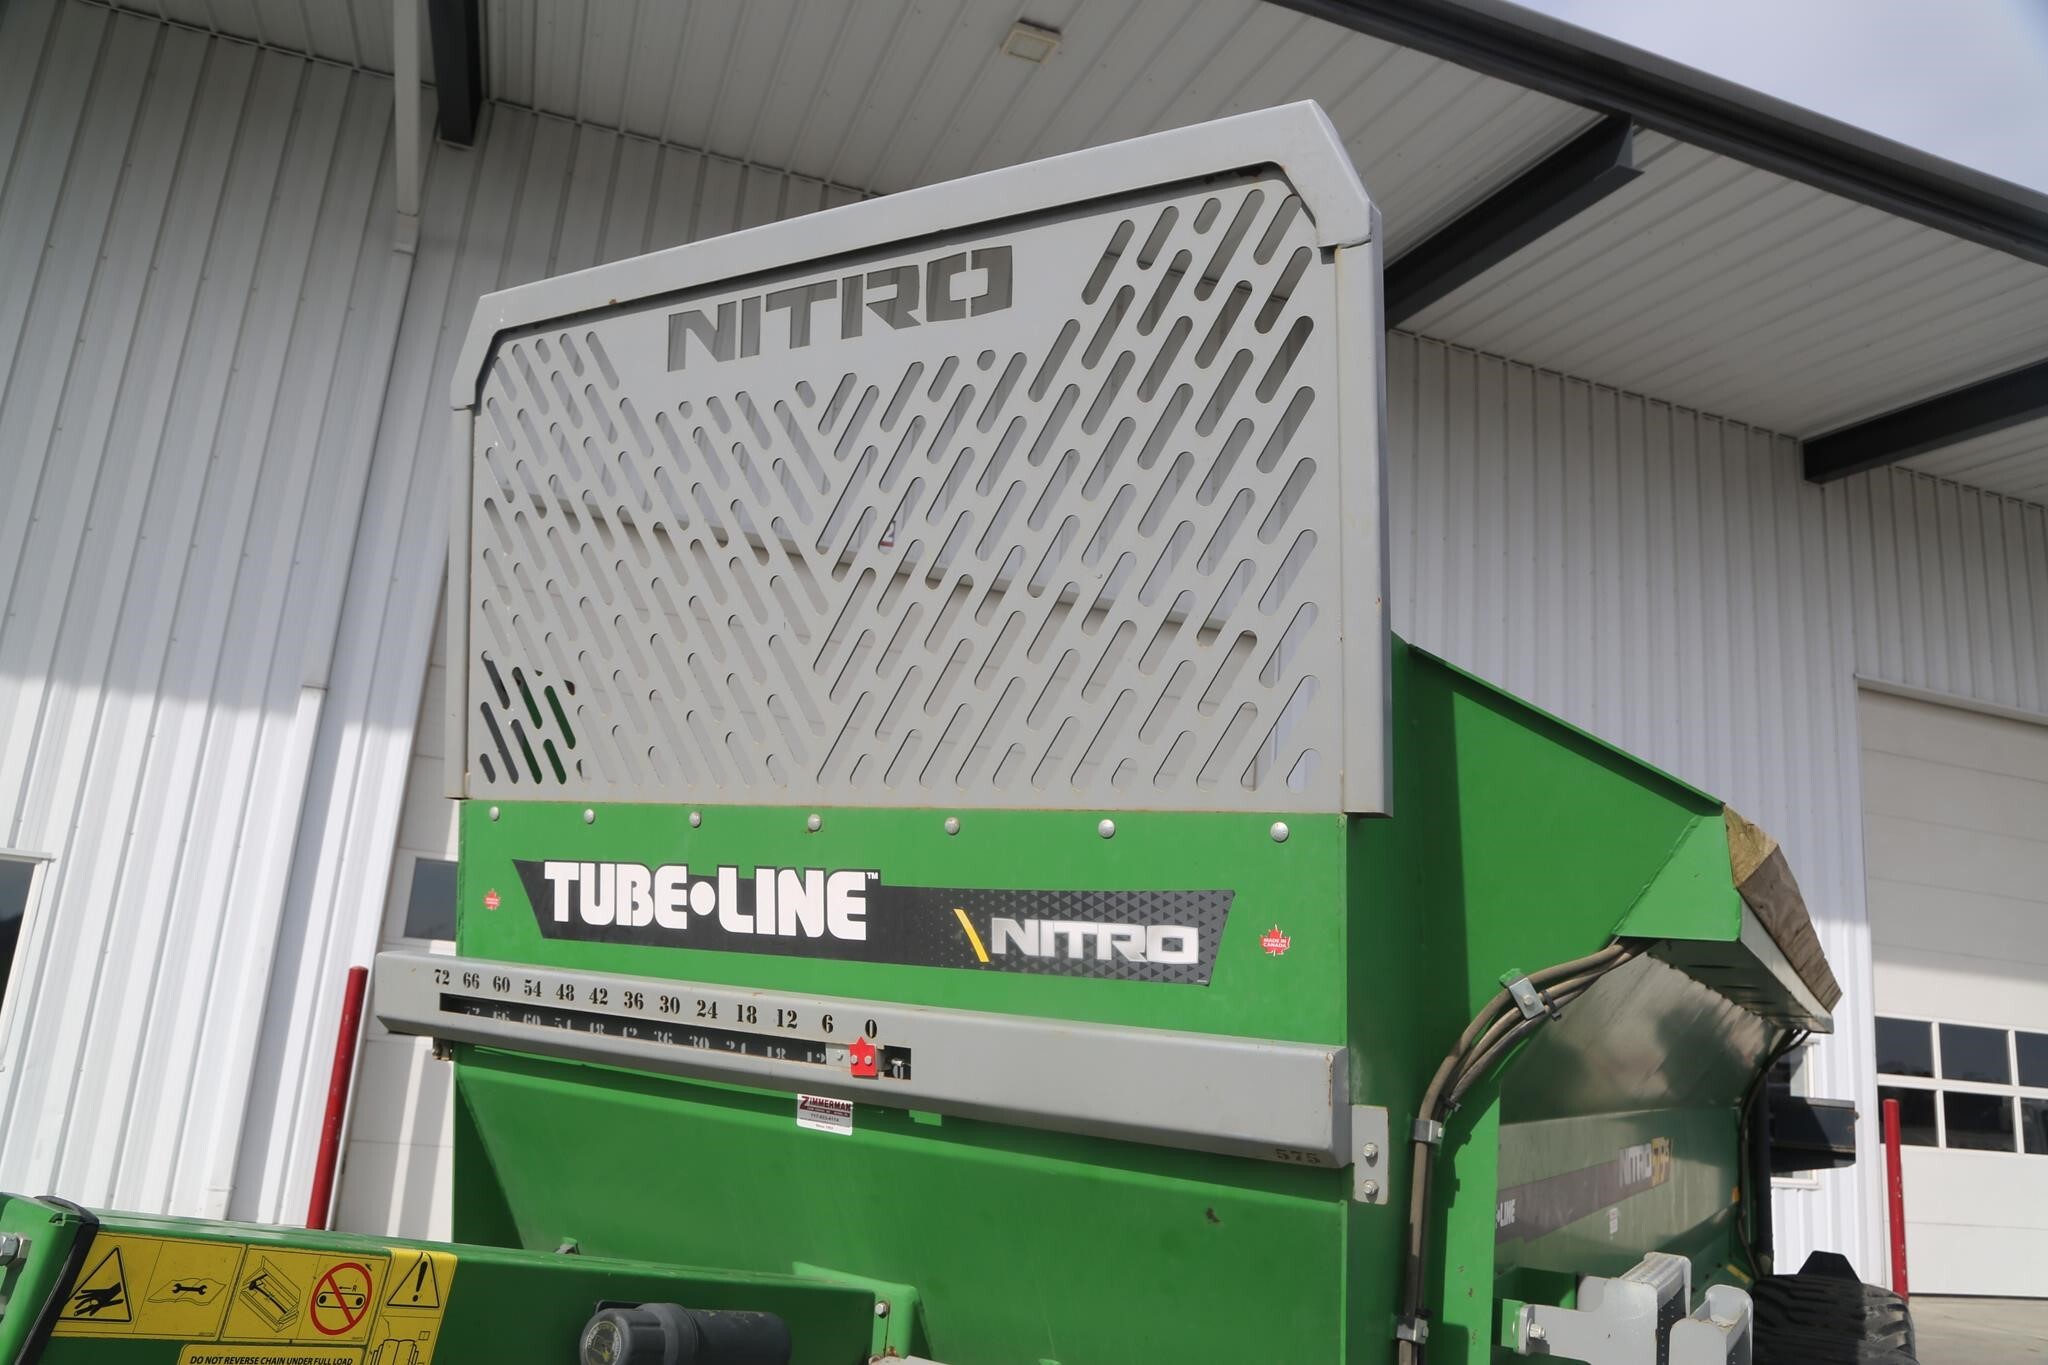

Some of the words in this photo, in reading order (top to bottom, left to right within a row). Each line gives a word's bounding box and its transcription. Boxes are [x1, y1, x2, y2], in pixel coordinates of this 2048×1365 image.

[668, 245, 1012, 372] NITRO
[991, 917, 1200, 964] NITRO
[434, 968, 450, 986] 72
[463, 972, 480, 989] 66
[493, 976, 510, 993] 60
[524, 979, 542, 997] 54
[555, 983, 575, 1001] 48
[589, 987, 608, 1005] 42
[624, 991, 644, 1010] 36
[660, 995, 681, 1014] 30
[696, 999, 718, 1019] 24
[737, 1004, 757, 1024] 18
[776, 1008, 798, 1029] 12
[822, 1014, 834, 1034] 6
[865, 1019, 878, 1039] 0
[800, 1096, 851, 1111] ZIMMERMAN
[190, 1356, 203, 1365] DO
[205, 1356, 224, 1365] NOT
[224, 1356, 259, 1365] REVERSE
[261, 1357, 285, 1365] CHAIN
[287, 1357, 313, 1365] UNDER
[314, 1357, 332, 1365] FULL
